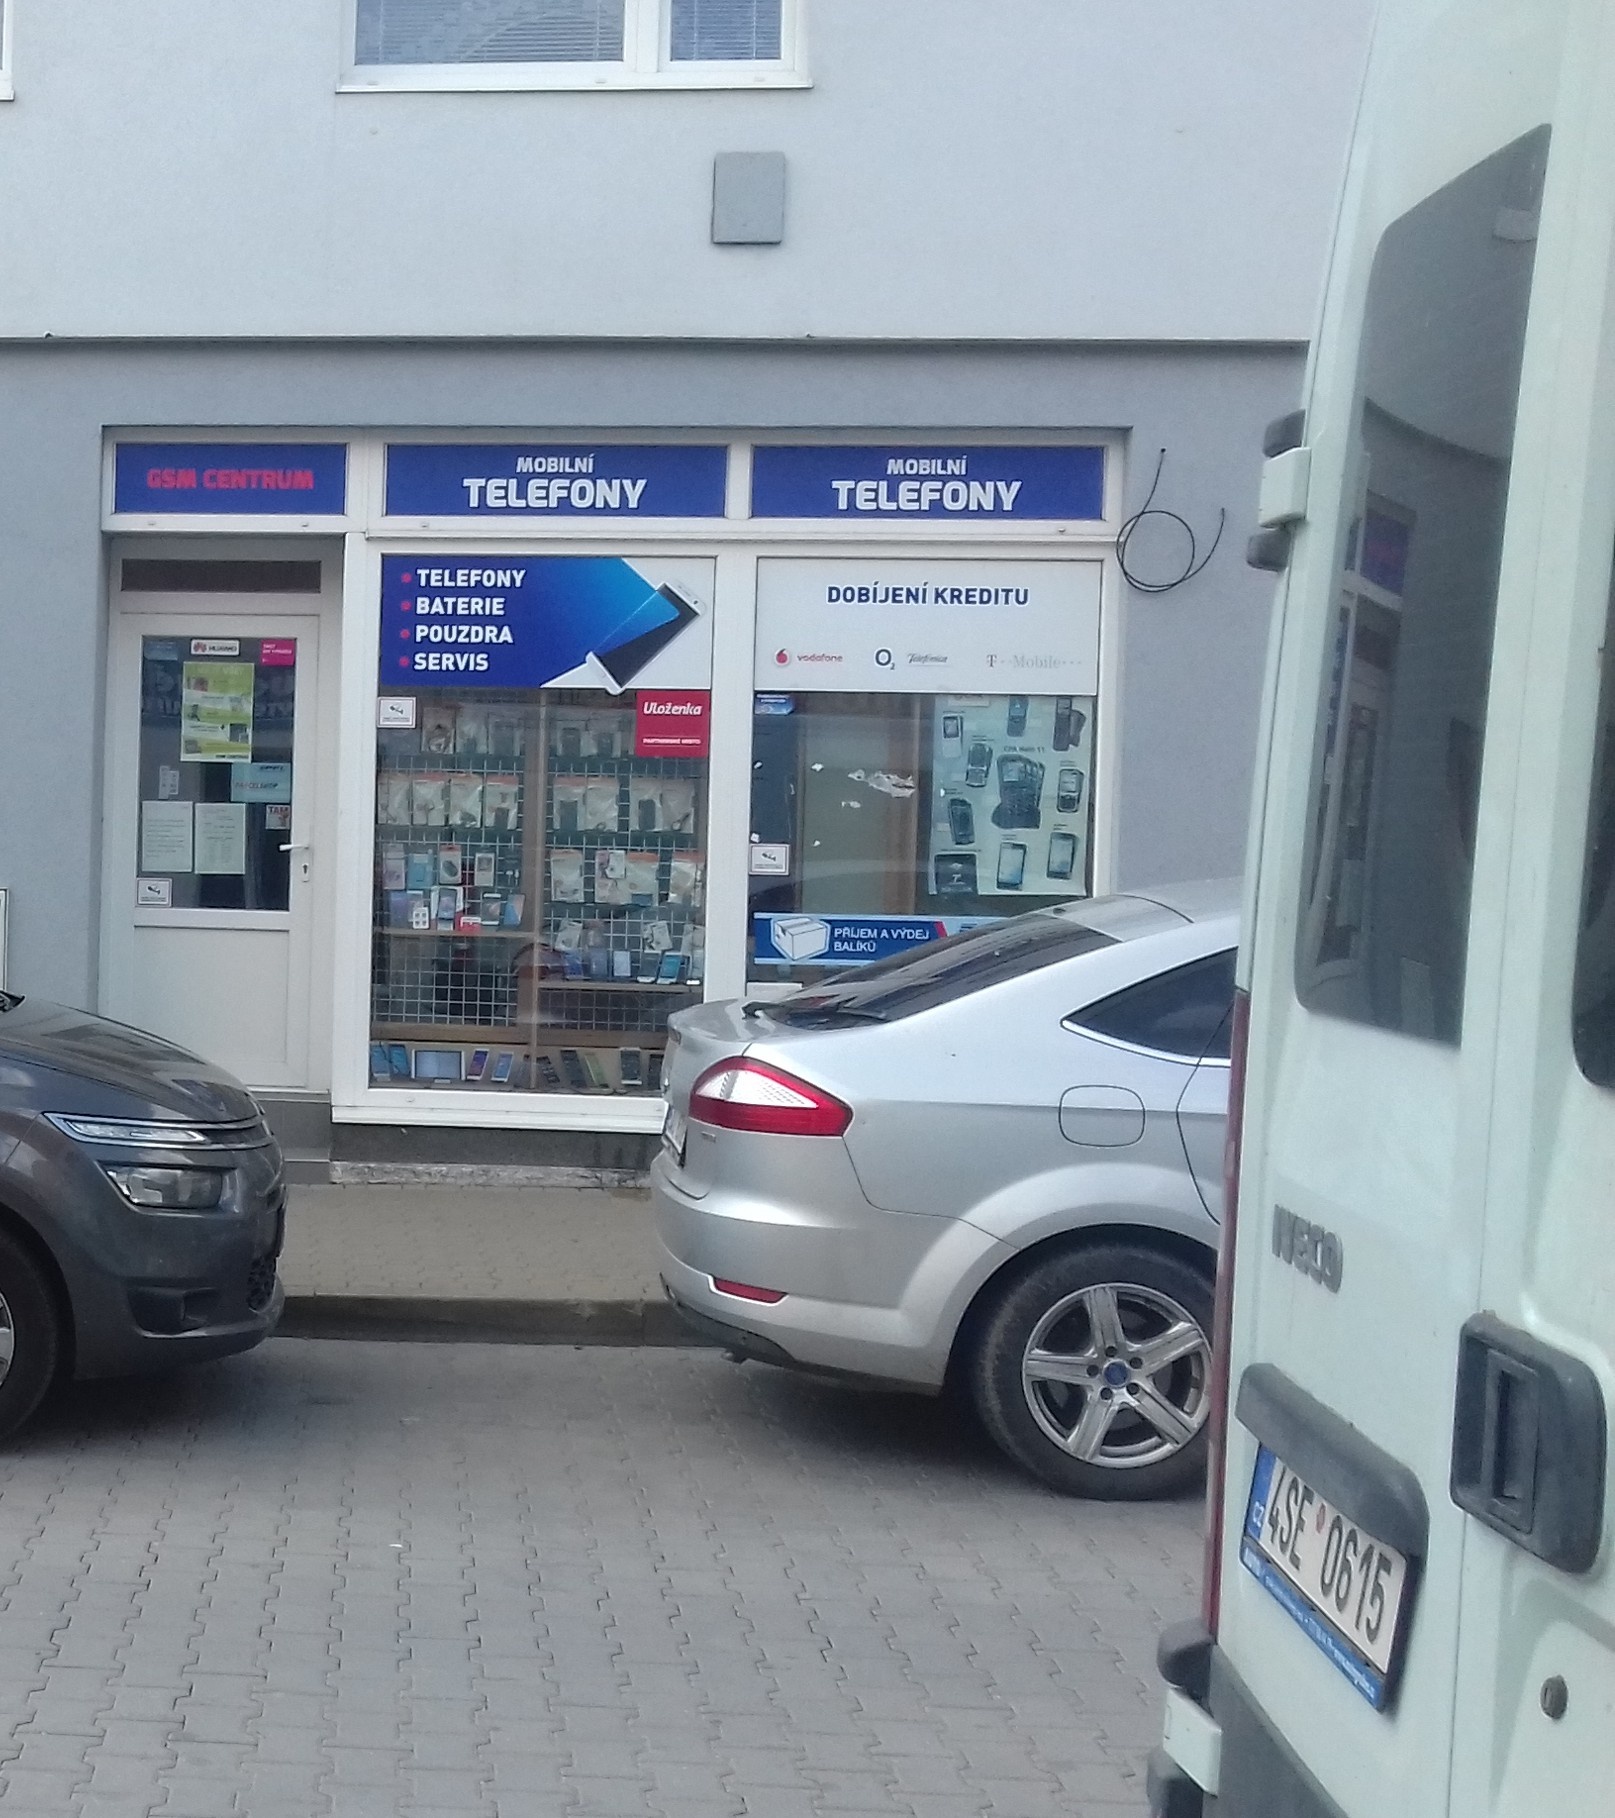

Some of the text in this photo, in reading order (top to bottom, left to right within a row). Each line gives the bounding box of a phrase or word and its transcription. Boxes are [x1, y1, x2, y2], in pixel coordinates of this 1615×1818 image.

[515, 453, 594, 473] MOBILNÍ
[886, 455, 968, 476] MOBILNÍ
[146, 468, 315, 489] GSM CENTRUM
[462, 478, 648, 509] TELEFONY
[831, 480, 1023, 511] TELEFONY
[416, 568, 526, 588] TELEFONY
[827, 581, 1030, 606] DOBÍJENÍ KREDITU
[415, 596, 506, 616] BATERIE
[414, 624, 514, 644] POUZDRA
[413, 652, 489, 671] SERVIS
[797, 651, 844, 663] vodafone
[643, 701, 703, 716] Uloženka
[833, 926, 930, 940] PŘÍJEM A VÝDEJ
[833, 940, 877, 953] BALÍKŮ
[1268, 1464, 1393, 1646] 4SE 0615
